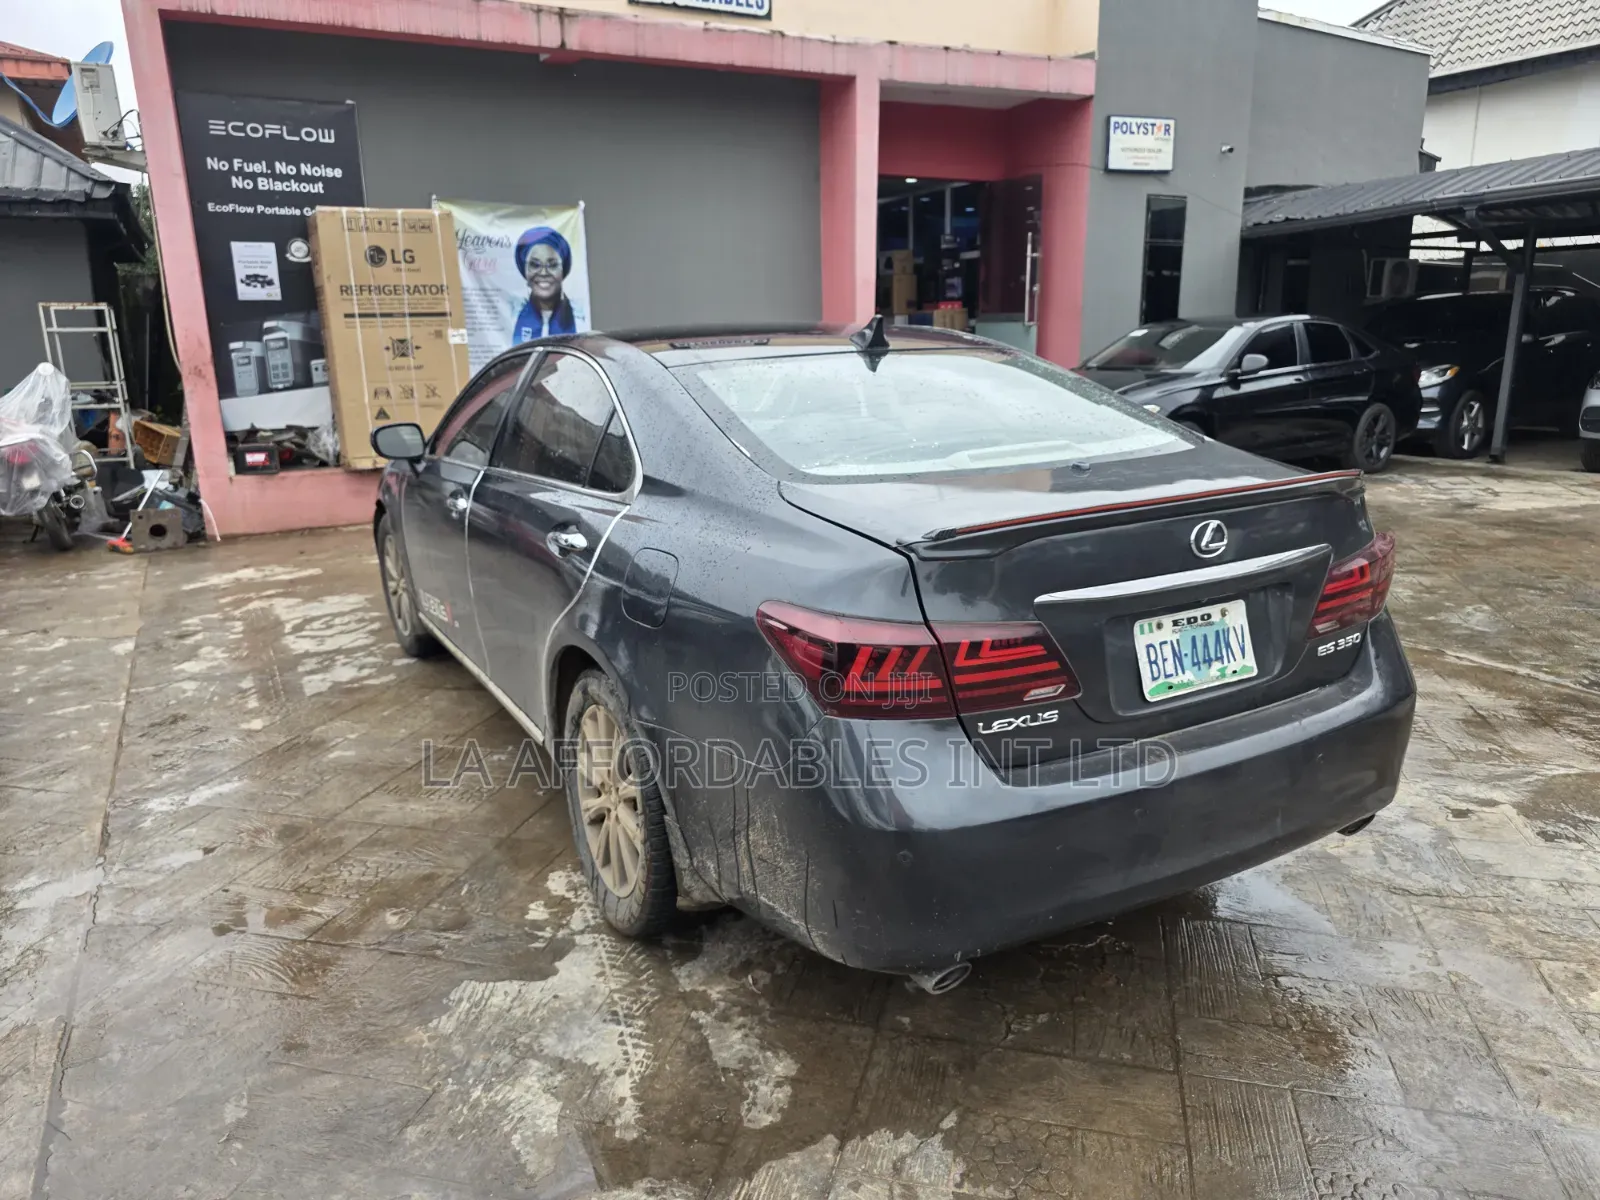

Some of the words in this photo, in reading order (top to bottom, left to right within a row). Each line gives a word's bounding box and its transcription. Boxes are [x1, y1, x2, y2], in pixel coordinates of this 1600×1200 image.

[208, 119, 335, 143] ECOFLOW
[206, 157, 229, 171] No
[275, 161, 297, 175] No
[300, 163, 343, 178] Noise
[231, 176, 253, 190] No
[257, 177, 324, 194] Blackout
[207, 203, 254, 214] EcoFlow
[257, 205, 301, 216] Portable
[390, 248, 416, 264] LG
[340, 284, 449, 297] REFRIGERATOR
[1172, 612, 1212, 627] EDO
[1317, 641, 1336, 657] ES
[1336, 632, 1361, 650] 350
[977, 710, 1059, 735] LEXUS
